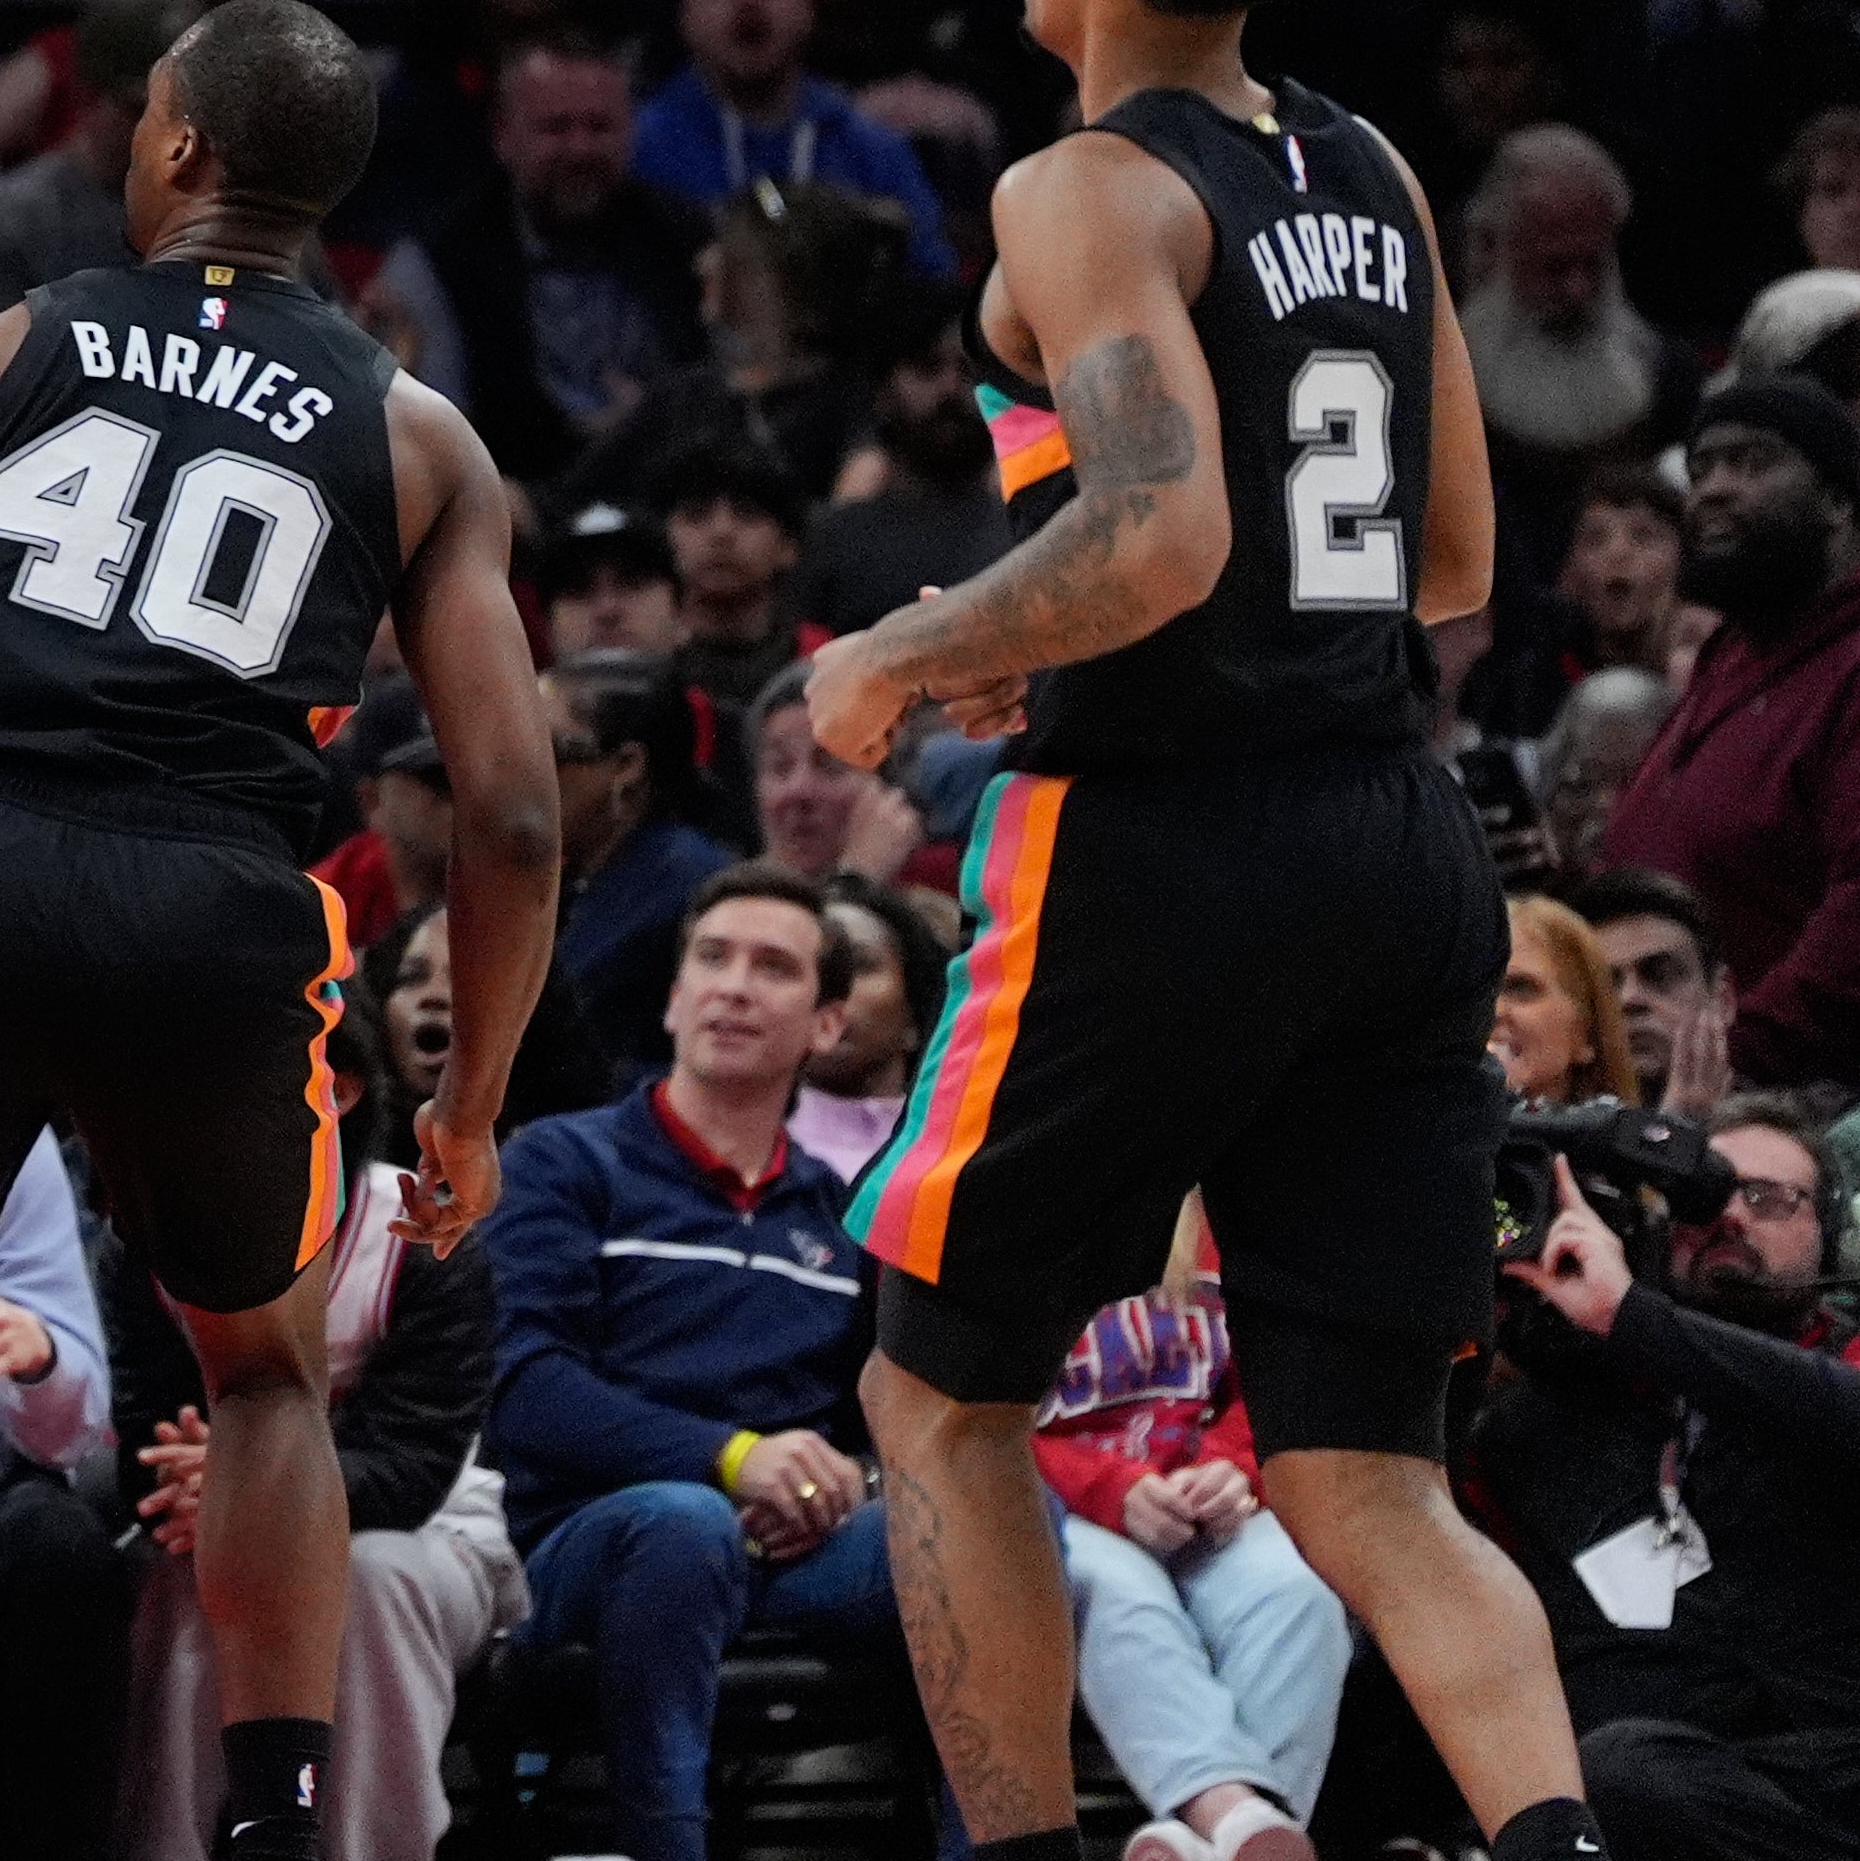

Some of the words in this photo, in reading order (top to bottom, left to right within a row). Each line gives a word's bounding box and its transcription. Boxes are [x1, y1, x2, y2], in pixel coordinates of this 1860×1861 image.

[1247, 212, 1409, 322] HARPER
[70, 320, 335, 446] BARNES
[1285, 349, 1407, 613] 2
